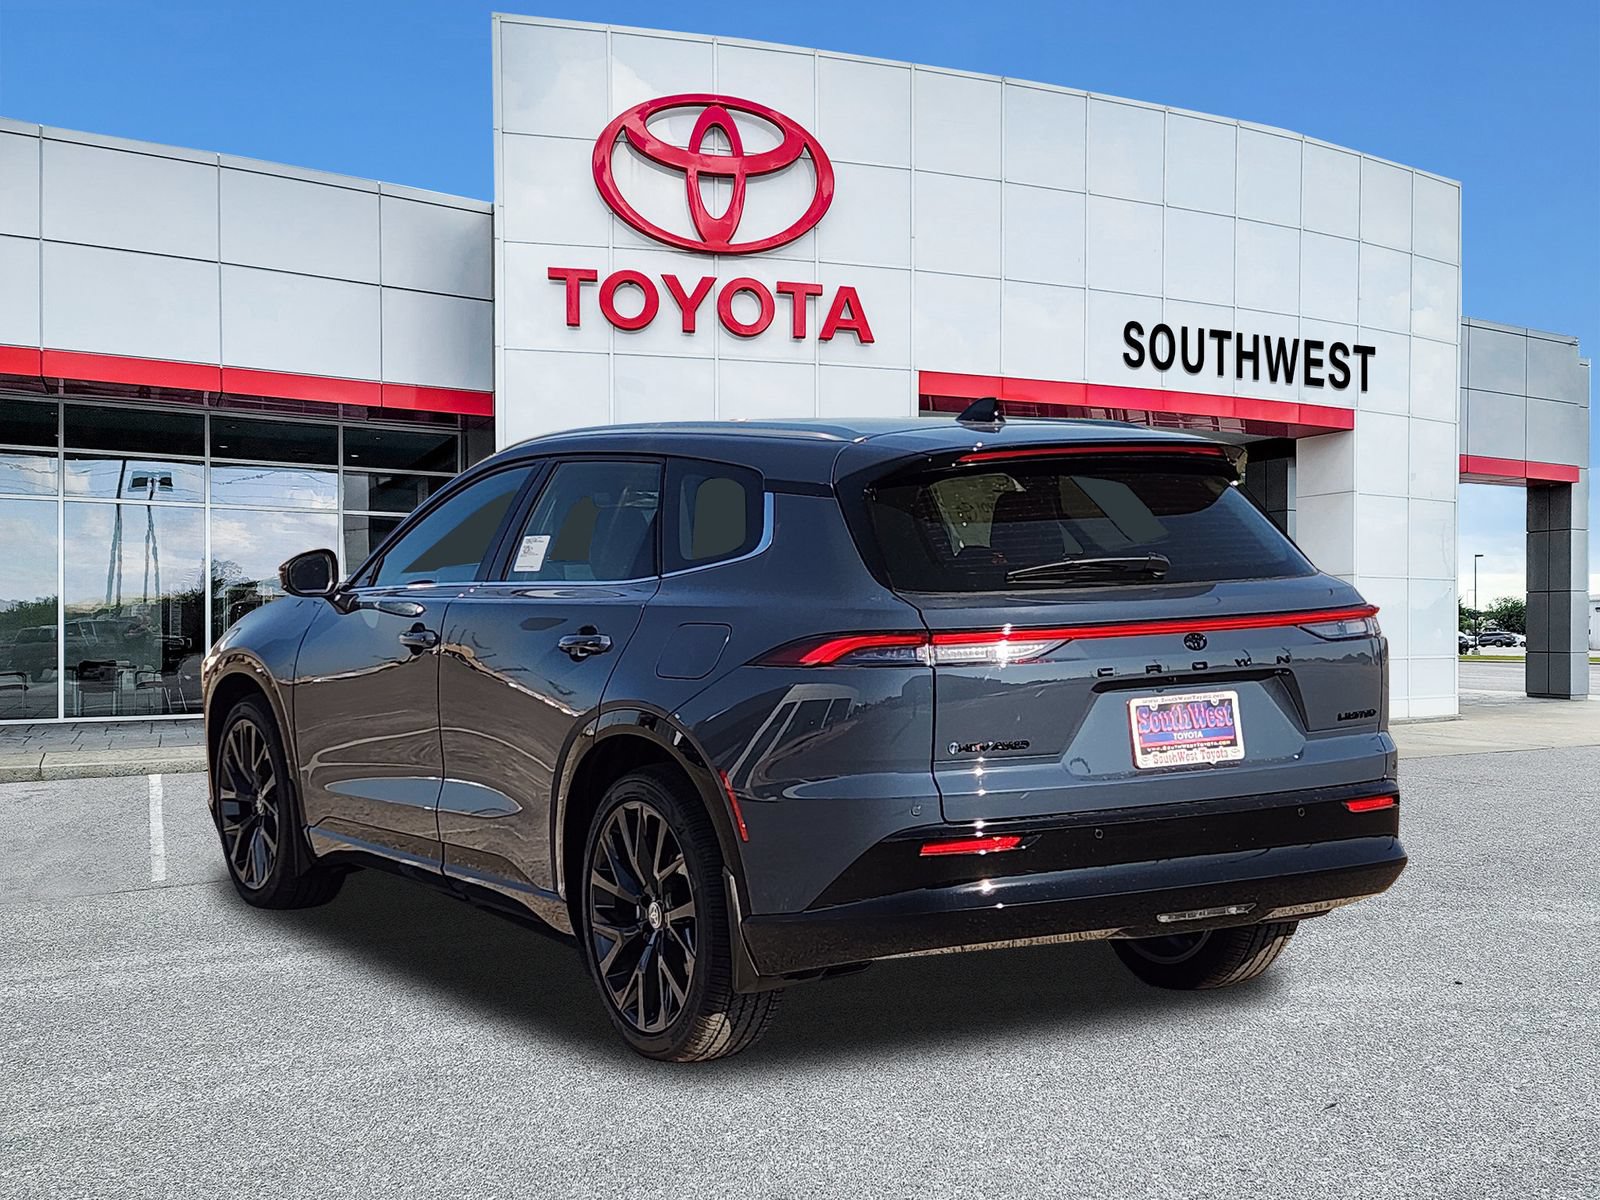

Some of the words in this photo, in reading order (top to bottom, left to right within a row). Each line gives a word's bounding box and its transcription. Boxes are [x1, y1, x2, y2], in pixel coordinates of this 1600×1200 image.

[548, 267, 875, 343] TOYOTA
[1123, 321, 1376, 392] SOUTHWEST
[1097, 655, 1291, 678] CROWN
[1173, 731, 1204, 741] TOYOTA
[1200, 747, 1229, 762] Toyota
